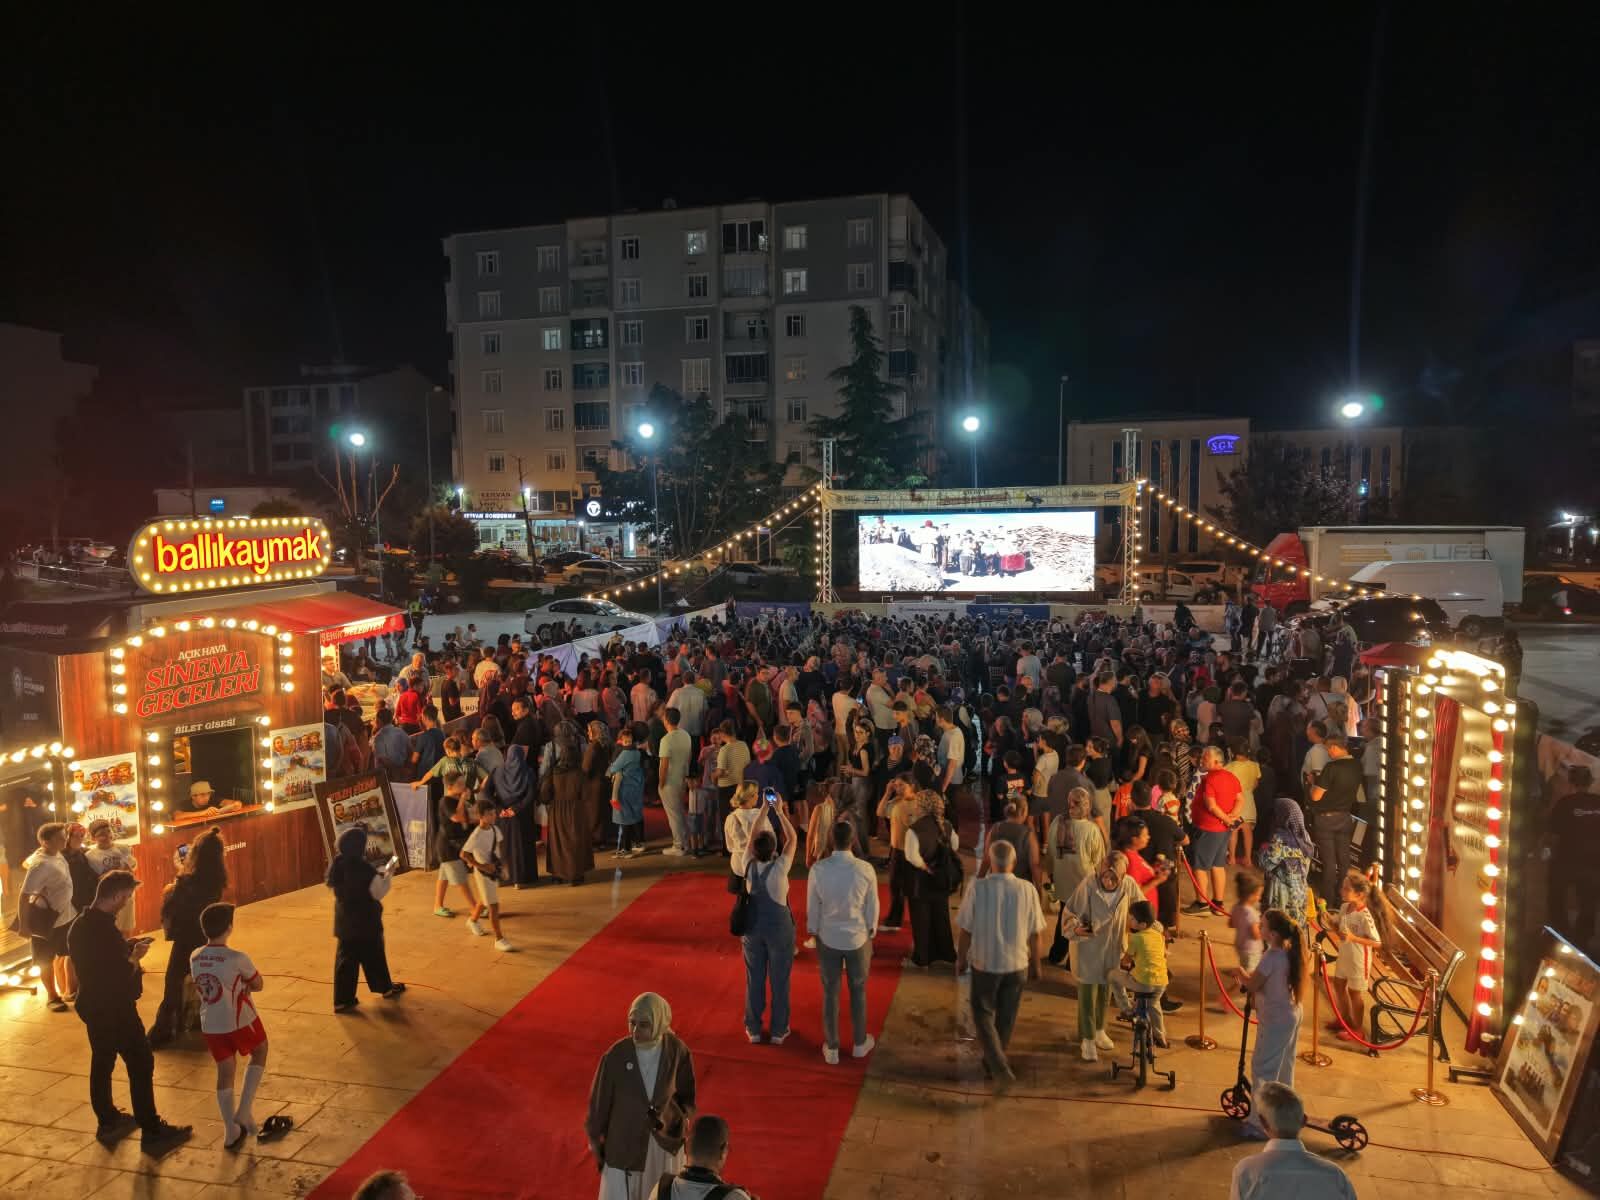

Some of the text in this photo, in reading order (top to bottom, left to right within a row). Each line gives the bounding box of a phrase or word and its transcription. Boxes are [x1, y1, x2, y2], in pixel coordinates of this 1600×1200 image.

[145, 650, 250, 692] SİNEMA
[178, 644, 228, 662] AÇIK HAVA
[136, 663, 262, 717] GECELERİ
